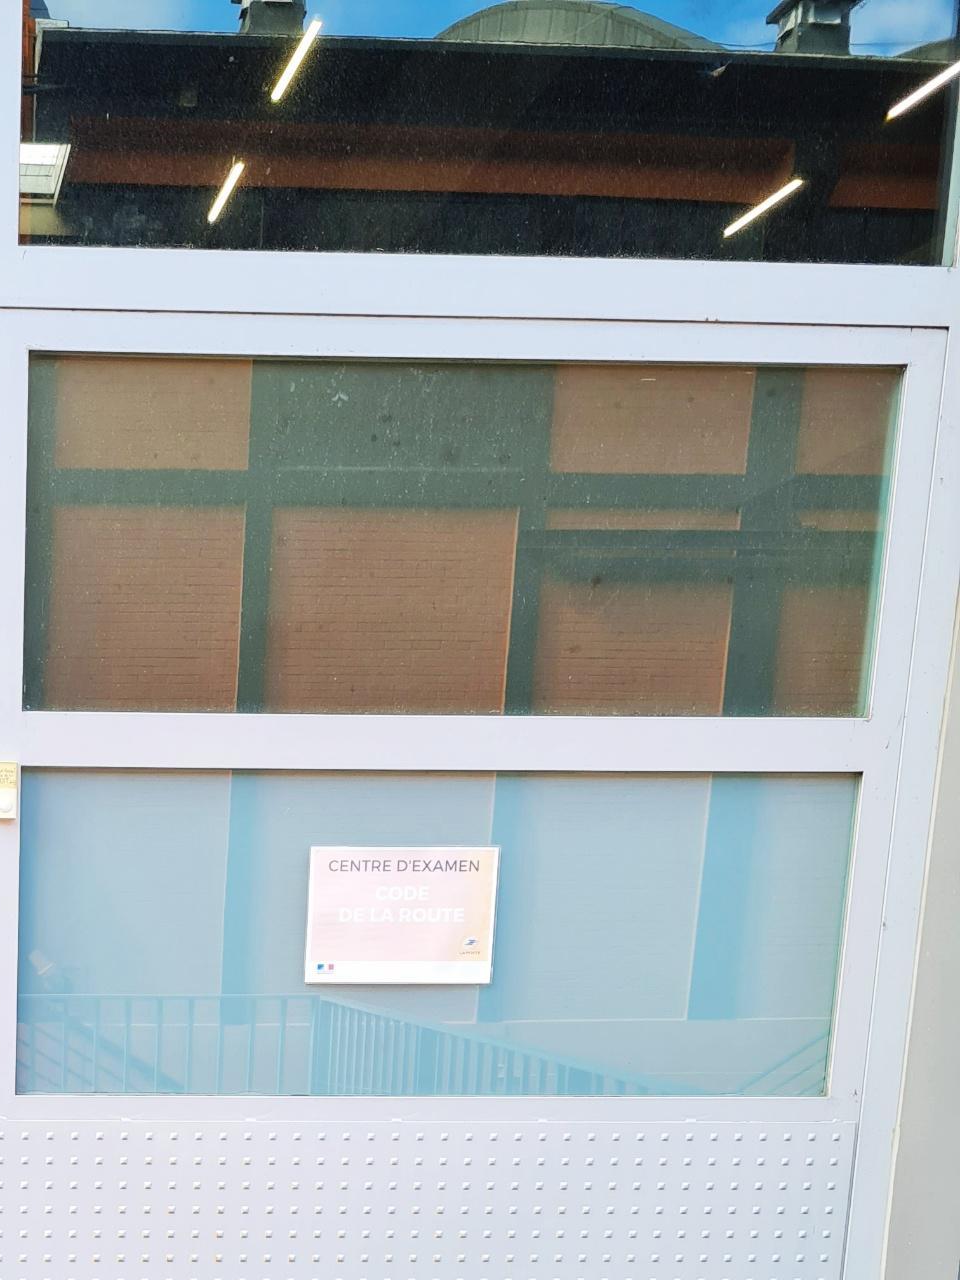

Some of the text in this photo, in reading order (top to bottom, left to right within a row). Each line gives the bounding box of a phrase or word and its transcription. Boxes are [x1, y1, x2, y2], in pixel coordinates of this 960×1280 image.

[328, 860, 480, 872] CENTRE D'EXAMEN
[375, 886, 429, 901] CODE
[339, 908, 464, 922] DE LA ROUTE
